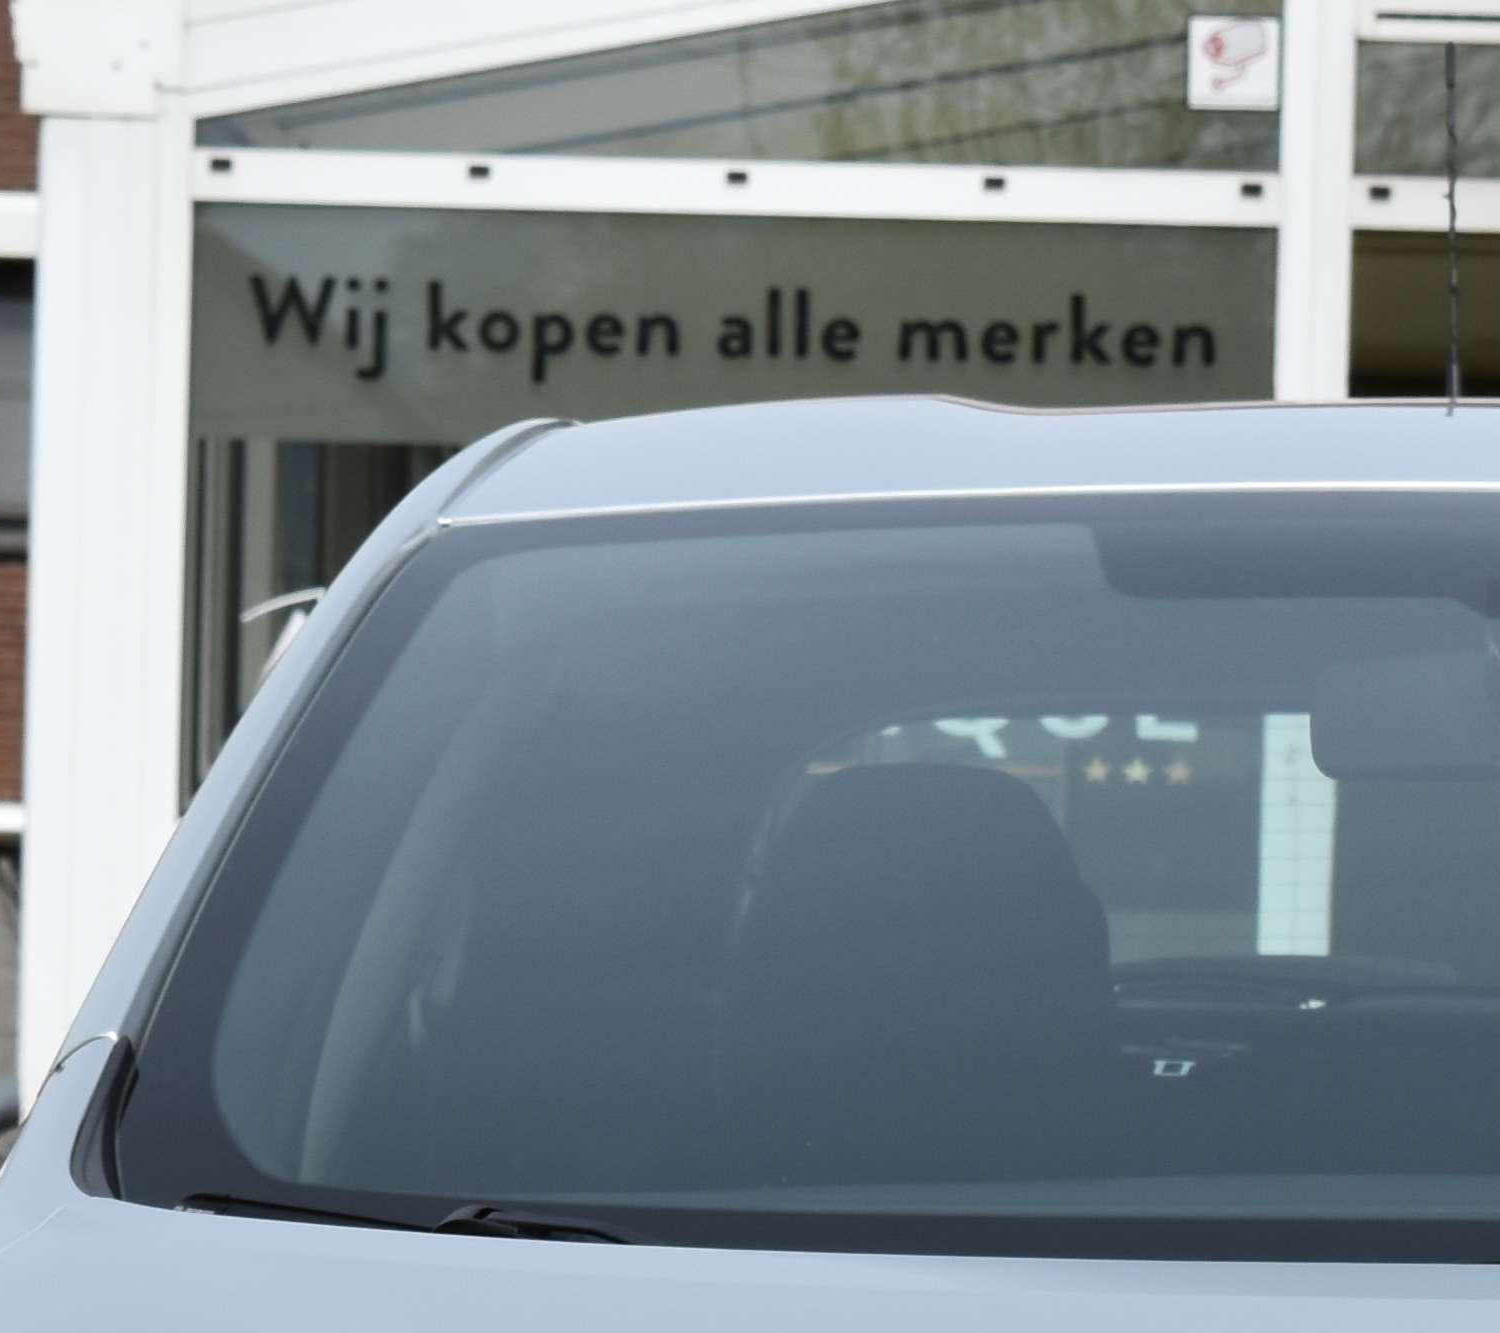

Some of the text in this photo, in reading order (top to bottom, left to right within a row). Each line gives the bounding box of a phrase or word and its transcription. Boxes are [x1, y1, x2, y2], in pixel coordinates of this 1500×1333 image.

[249, 275, 1216, 384] Wij kopen alle merken
